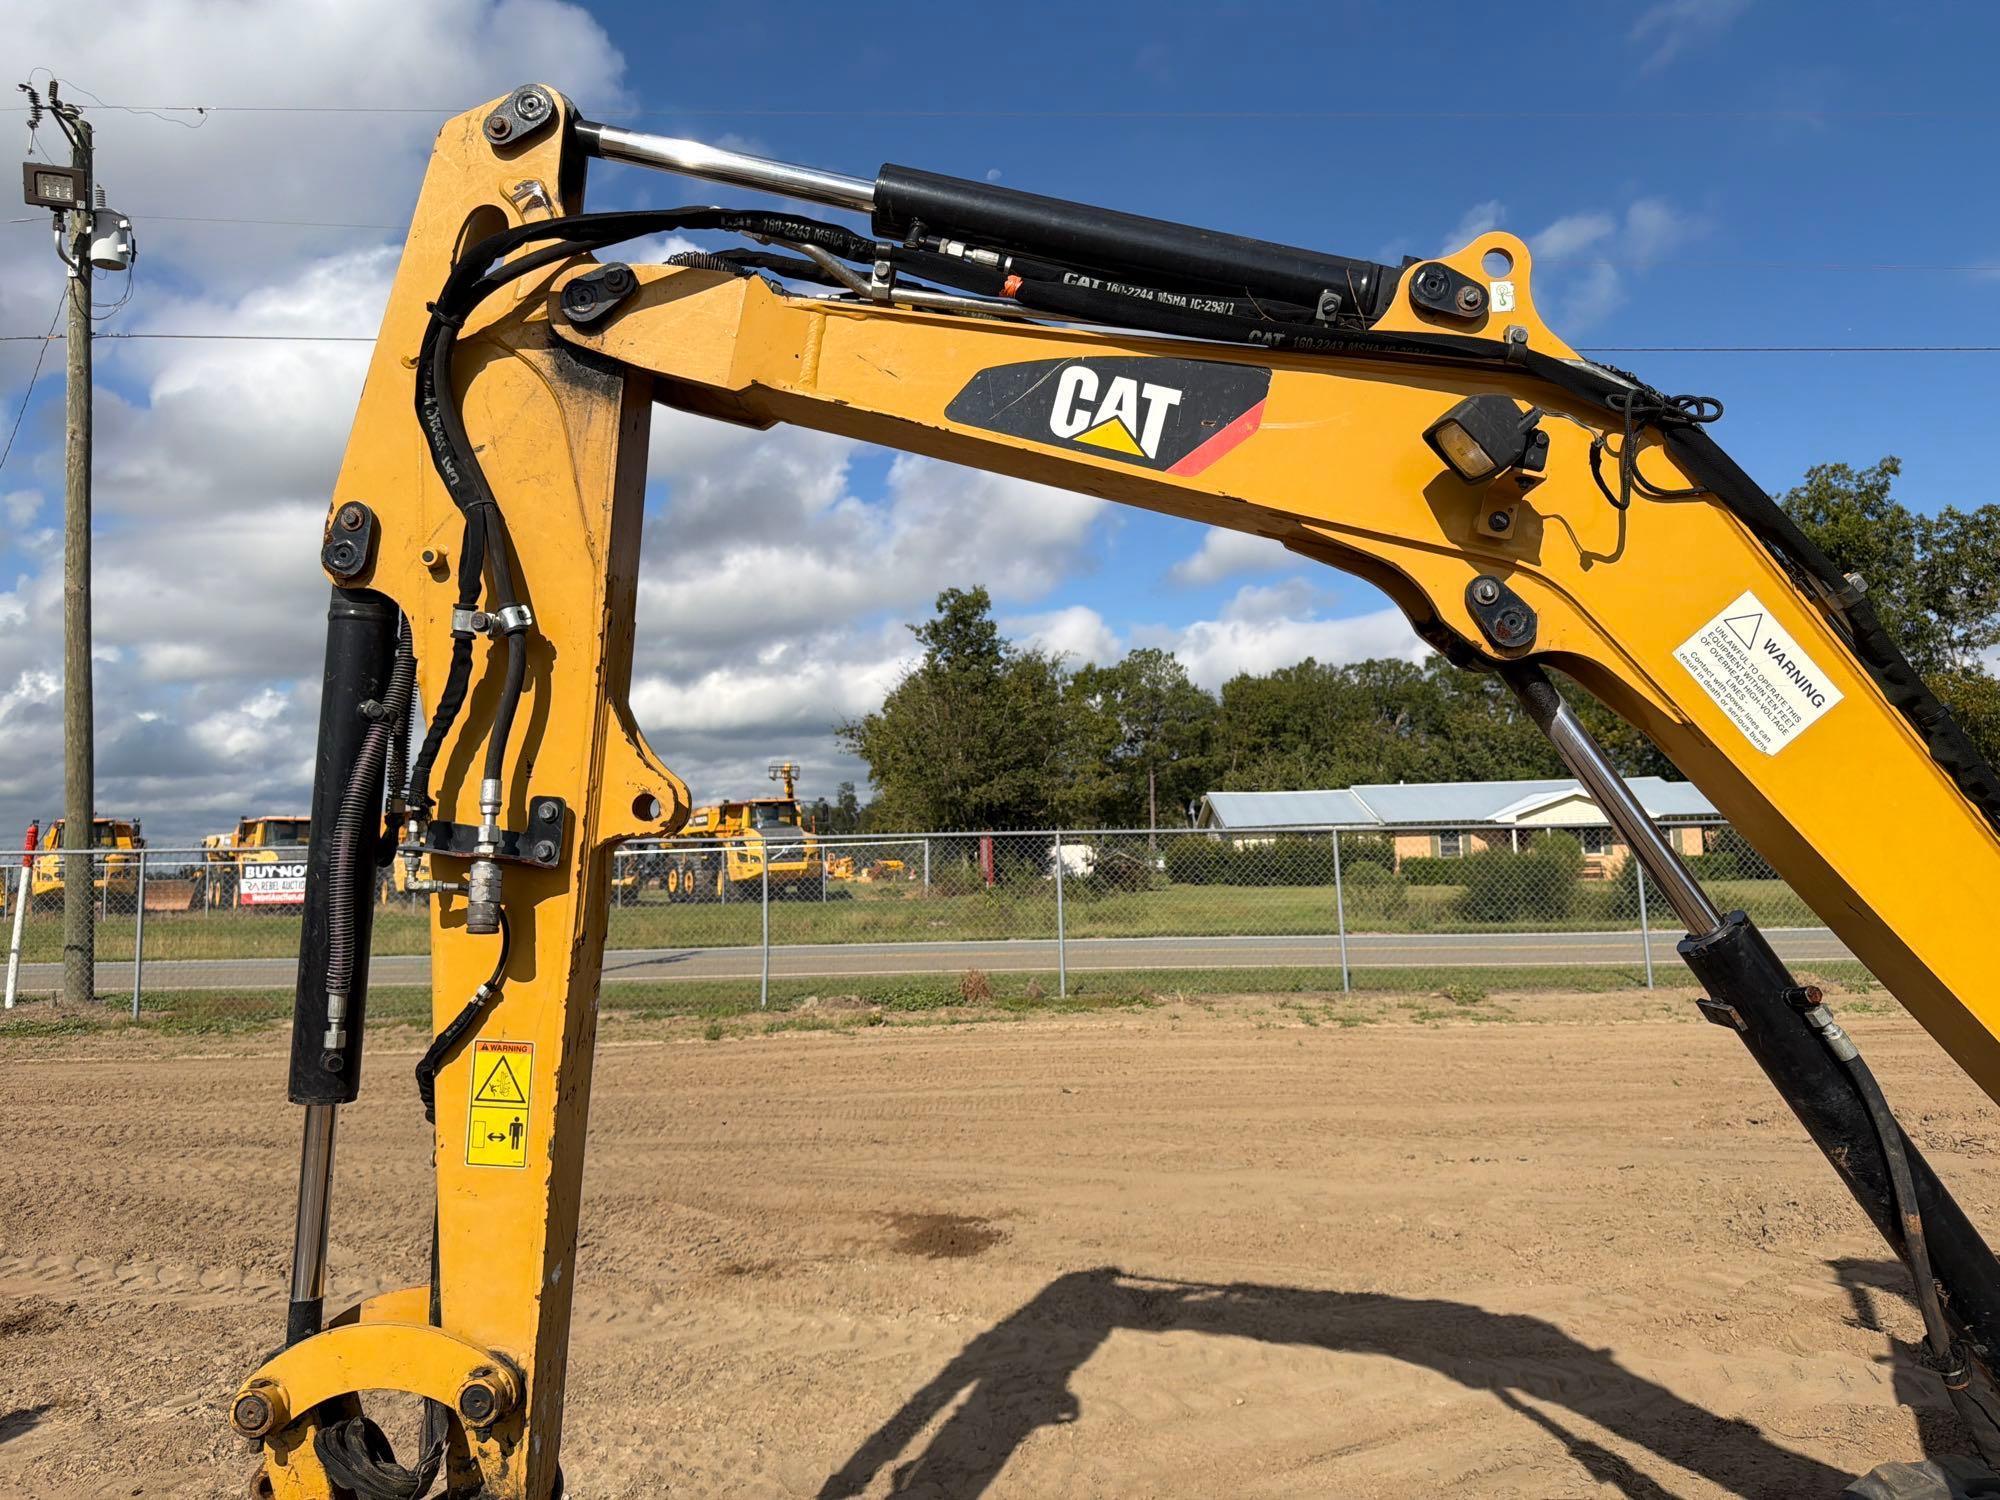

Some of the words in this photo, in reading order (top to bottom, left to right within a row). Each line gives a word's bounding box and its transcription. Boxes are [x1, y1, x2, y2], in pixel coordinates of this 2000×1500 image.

[814, 228, 844, 247] MSHA
[1063, 272, 1104, 290] CAT
[1106, 281, 1154, 301] 160-2244
[1157, 291, 1187, 308] MSHA
[1189, 298, 1236, 316] IC-293/1
[1248, 329, 1287, 346] CAT
[1050, 365, 1183, 460] CAT
[441, 456, 460, 487] CAT
[1679, 652, 1699, 673] result
[1703, 679, 1722, 700] death
[1727, 706, 1751, 733] serious
[1707, 631, 1746, 672] EQUIPMENT
[1743, 670, 1767, 698] WITHIN
[1764, 694, 1780, 712] TEN
[1776, 709, 1797, 729] FEET
[1709, 647, 1746, 686] OVERHEAD
[1742, 684, 1790, 737] HIGH-VOLTAGE
[1714, 625, 1749, 666] UNLAWFUL
[1757, 674, 1789, 708] OPERATE
[1785, 705, 1802, 724] THIS
[1725, 678, 1747, 701] LINES
[1763, 637, 1826, 709] WARNING
[1690, 651, 1715, 679] Contact
[1713, 677, 1728, 694] with
[1724, 692, 1746, 713] power
[1744, 712, 1760, 731] lines
[1758, 729, 1772, 744] can
[245, 865, 275, 879] BUY
[279, 864, 308, 878] NO
[261, 881, 279, 891] REBEL
[281, 880, 305, 890] AUCTIO
[490, 1044, 528, 1053] WARNING
